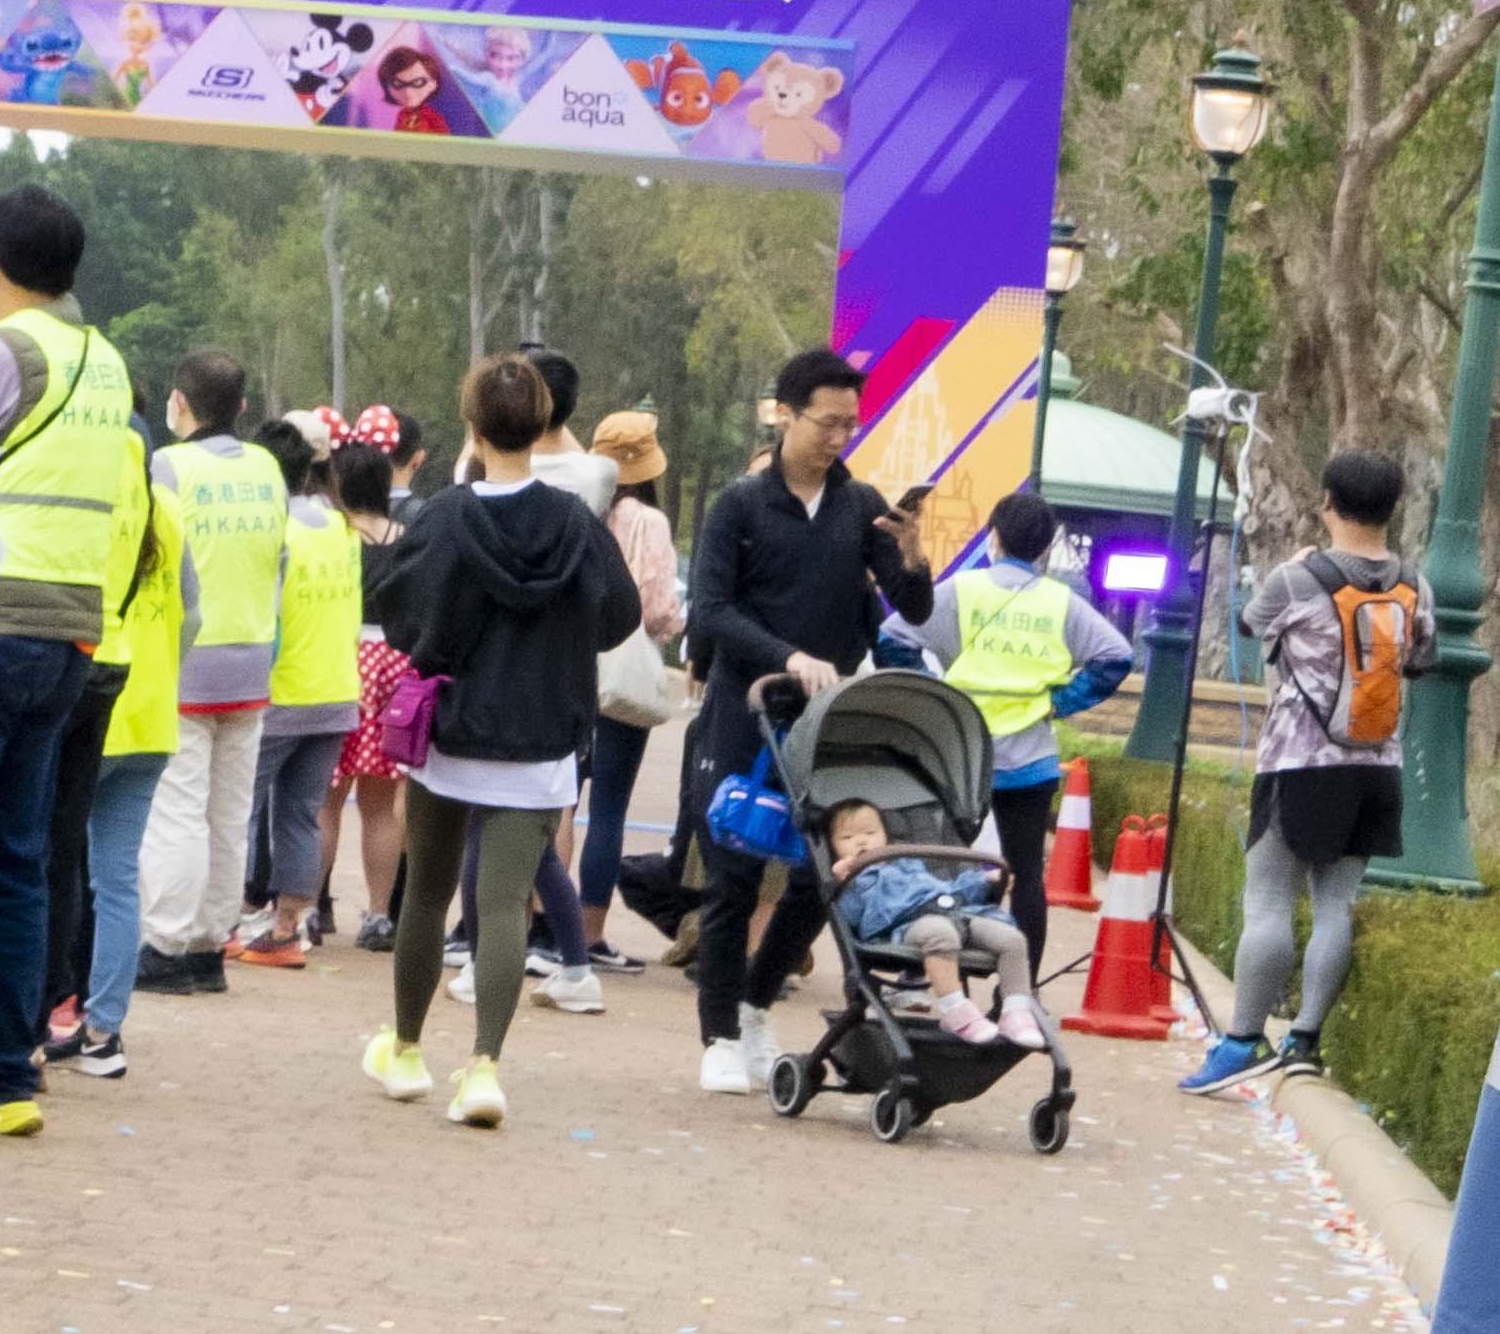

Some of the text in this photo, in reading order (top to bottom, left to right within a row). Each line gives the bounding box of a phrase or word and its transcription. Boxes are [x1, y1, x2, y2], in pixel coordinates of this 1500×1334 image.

[186, 88, 266, 101] SKECHERS
[562, 84, 611, 107] bon
[562, 107, 625, 128] aqua
